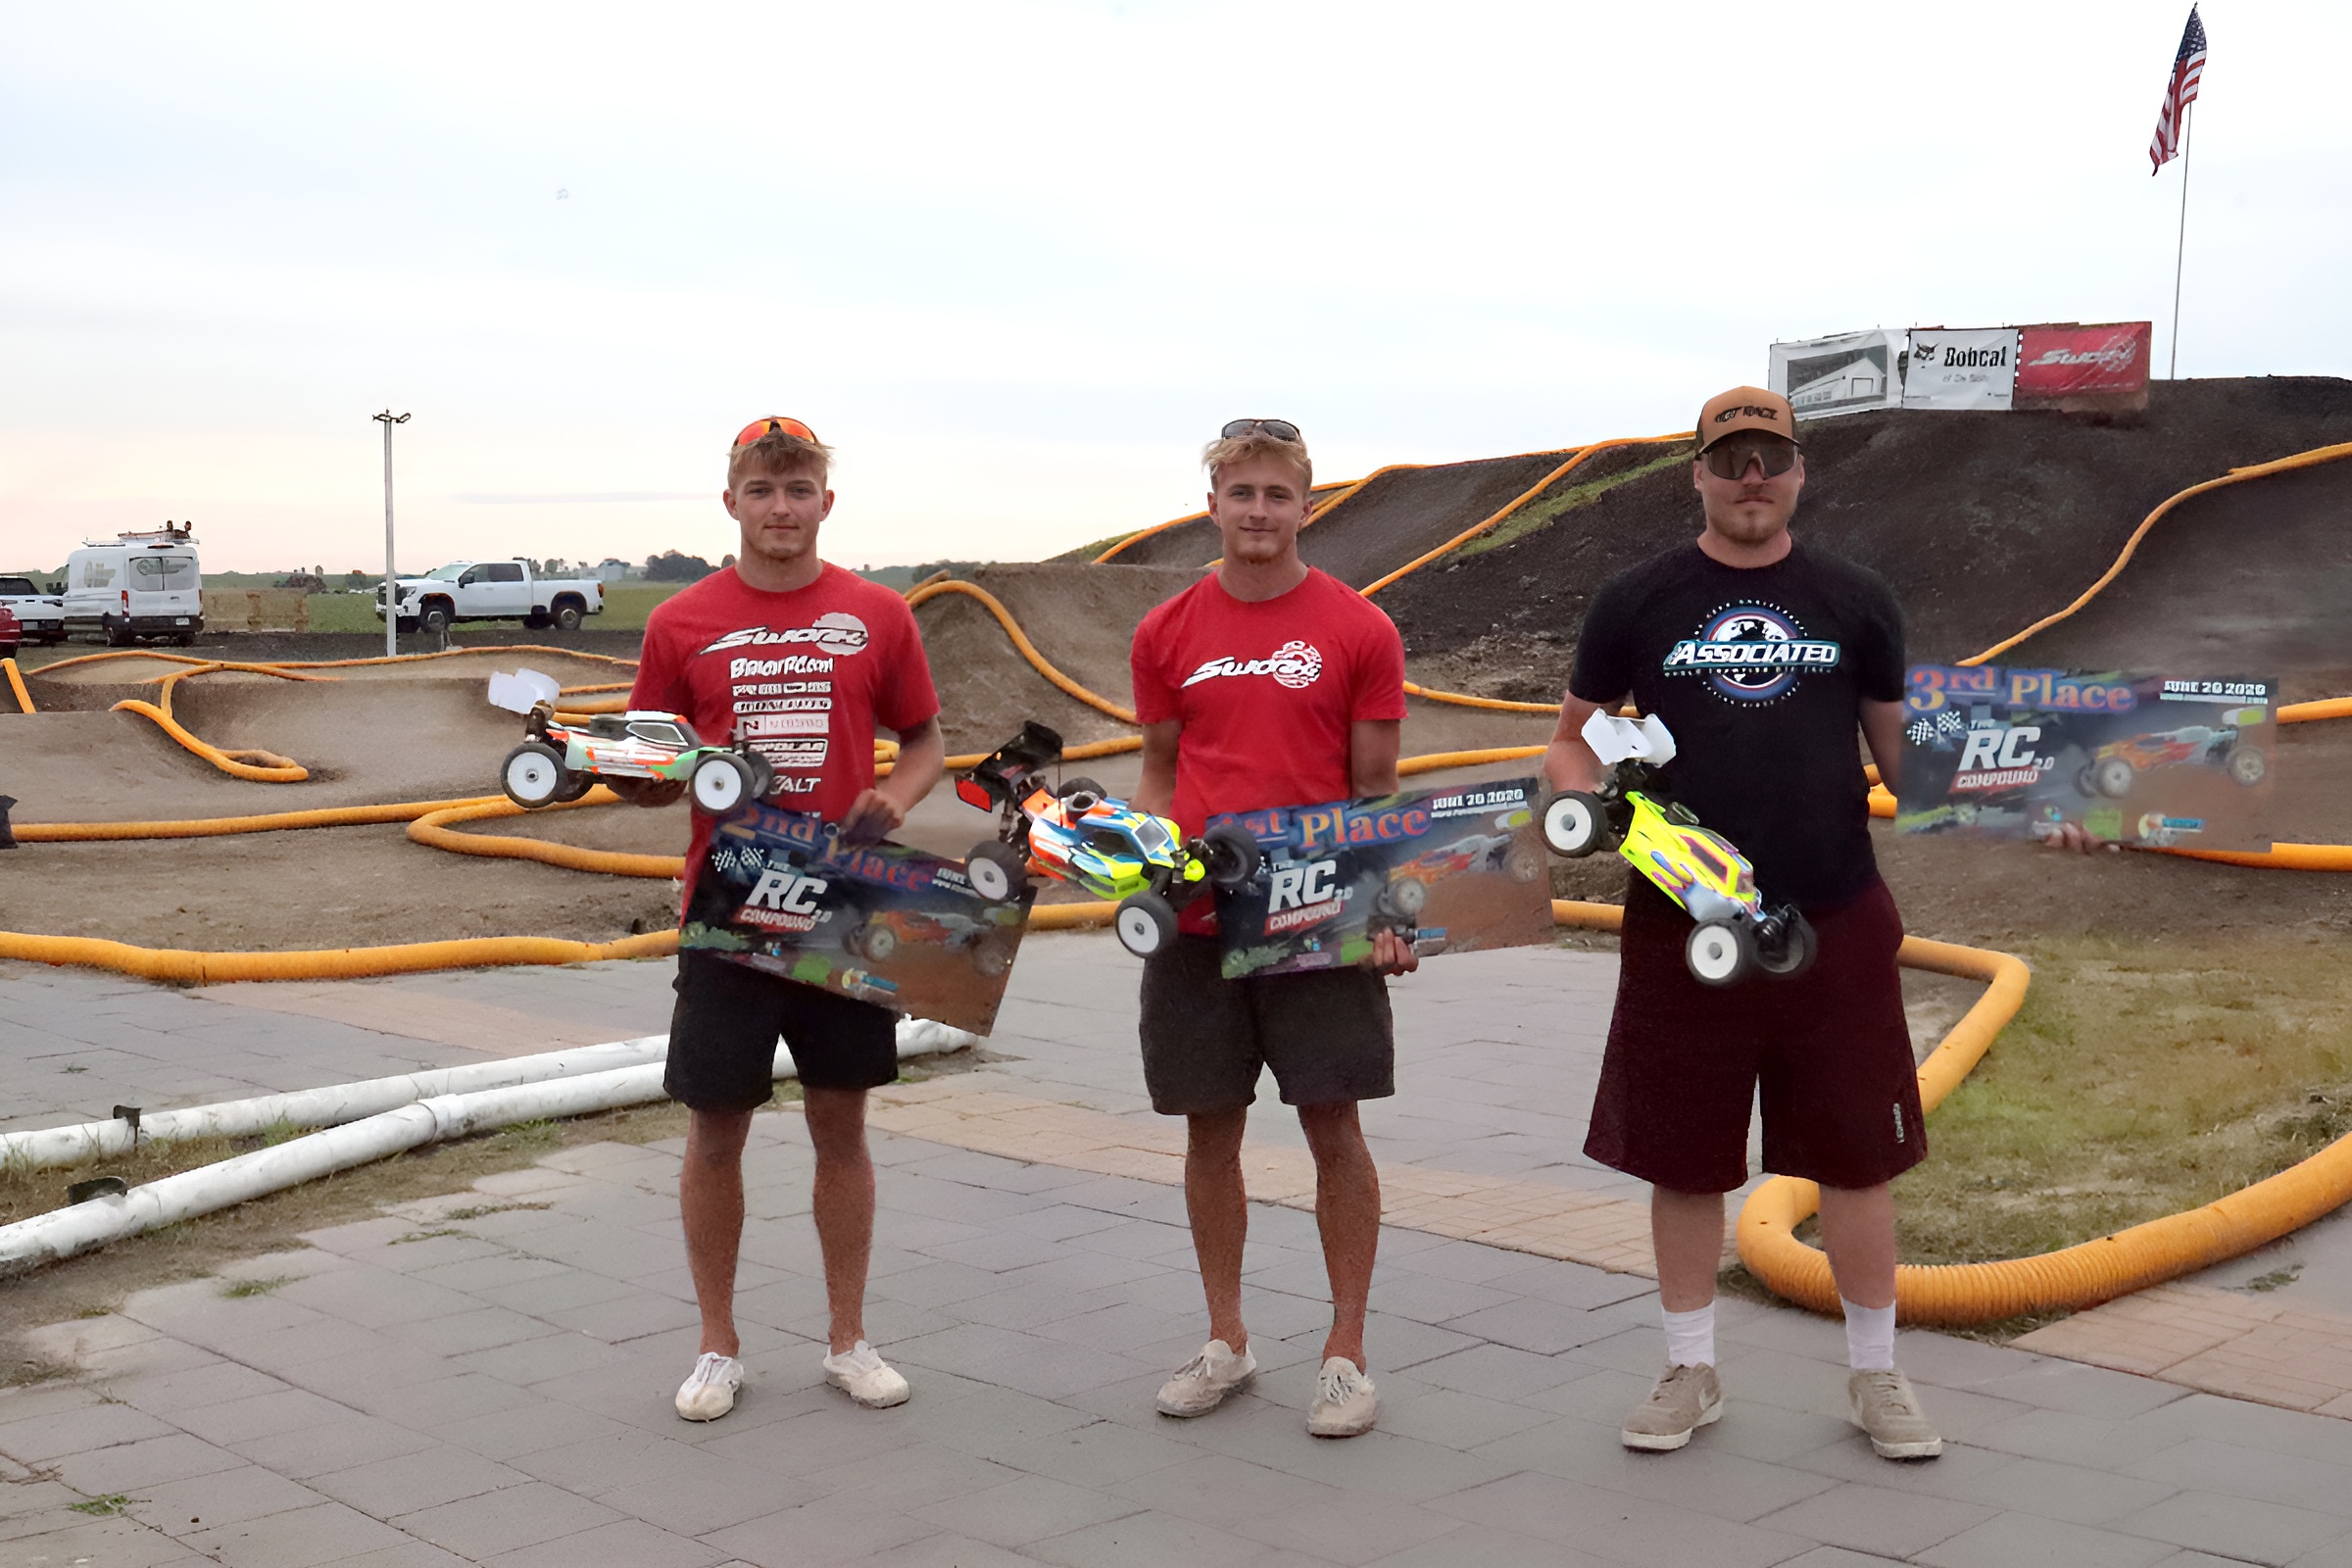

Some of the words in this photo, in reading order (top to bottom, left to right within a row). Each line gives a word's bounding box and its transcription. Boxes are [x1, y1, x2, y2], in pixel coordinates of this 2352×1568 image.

[1668, 642, 1837, 665] ASSOCIATED
[1909, 666, 1995, 711] 3rd
[2008, 673, 2133, 710] Place
[1957, 726, 2041, 772] RC
[1299, 806, 1429, 848] Place
[745, 867, 828, 915] RC
[1268, 859, 1337, 914] RC
